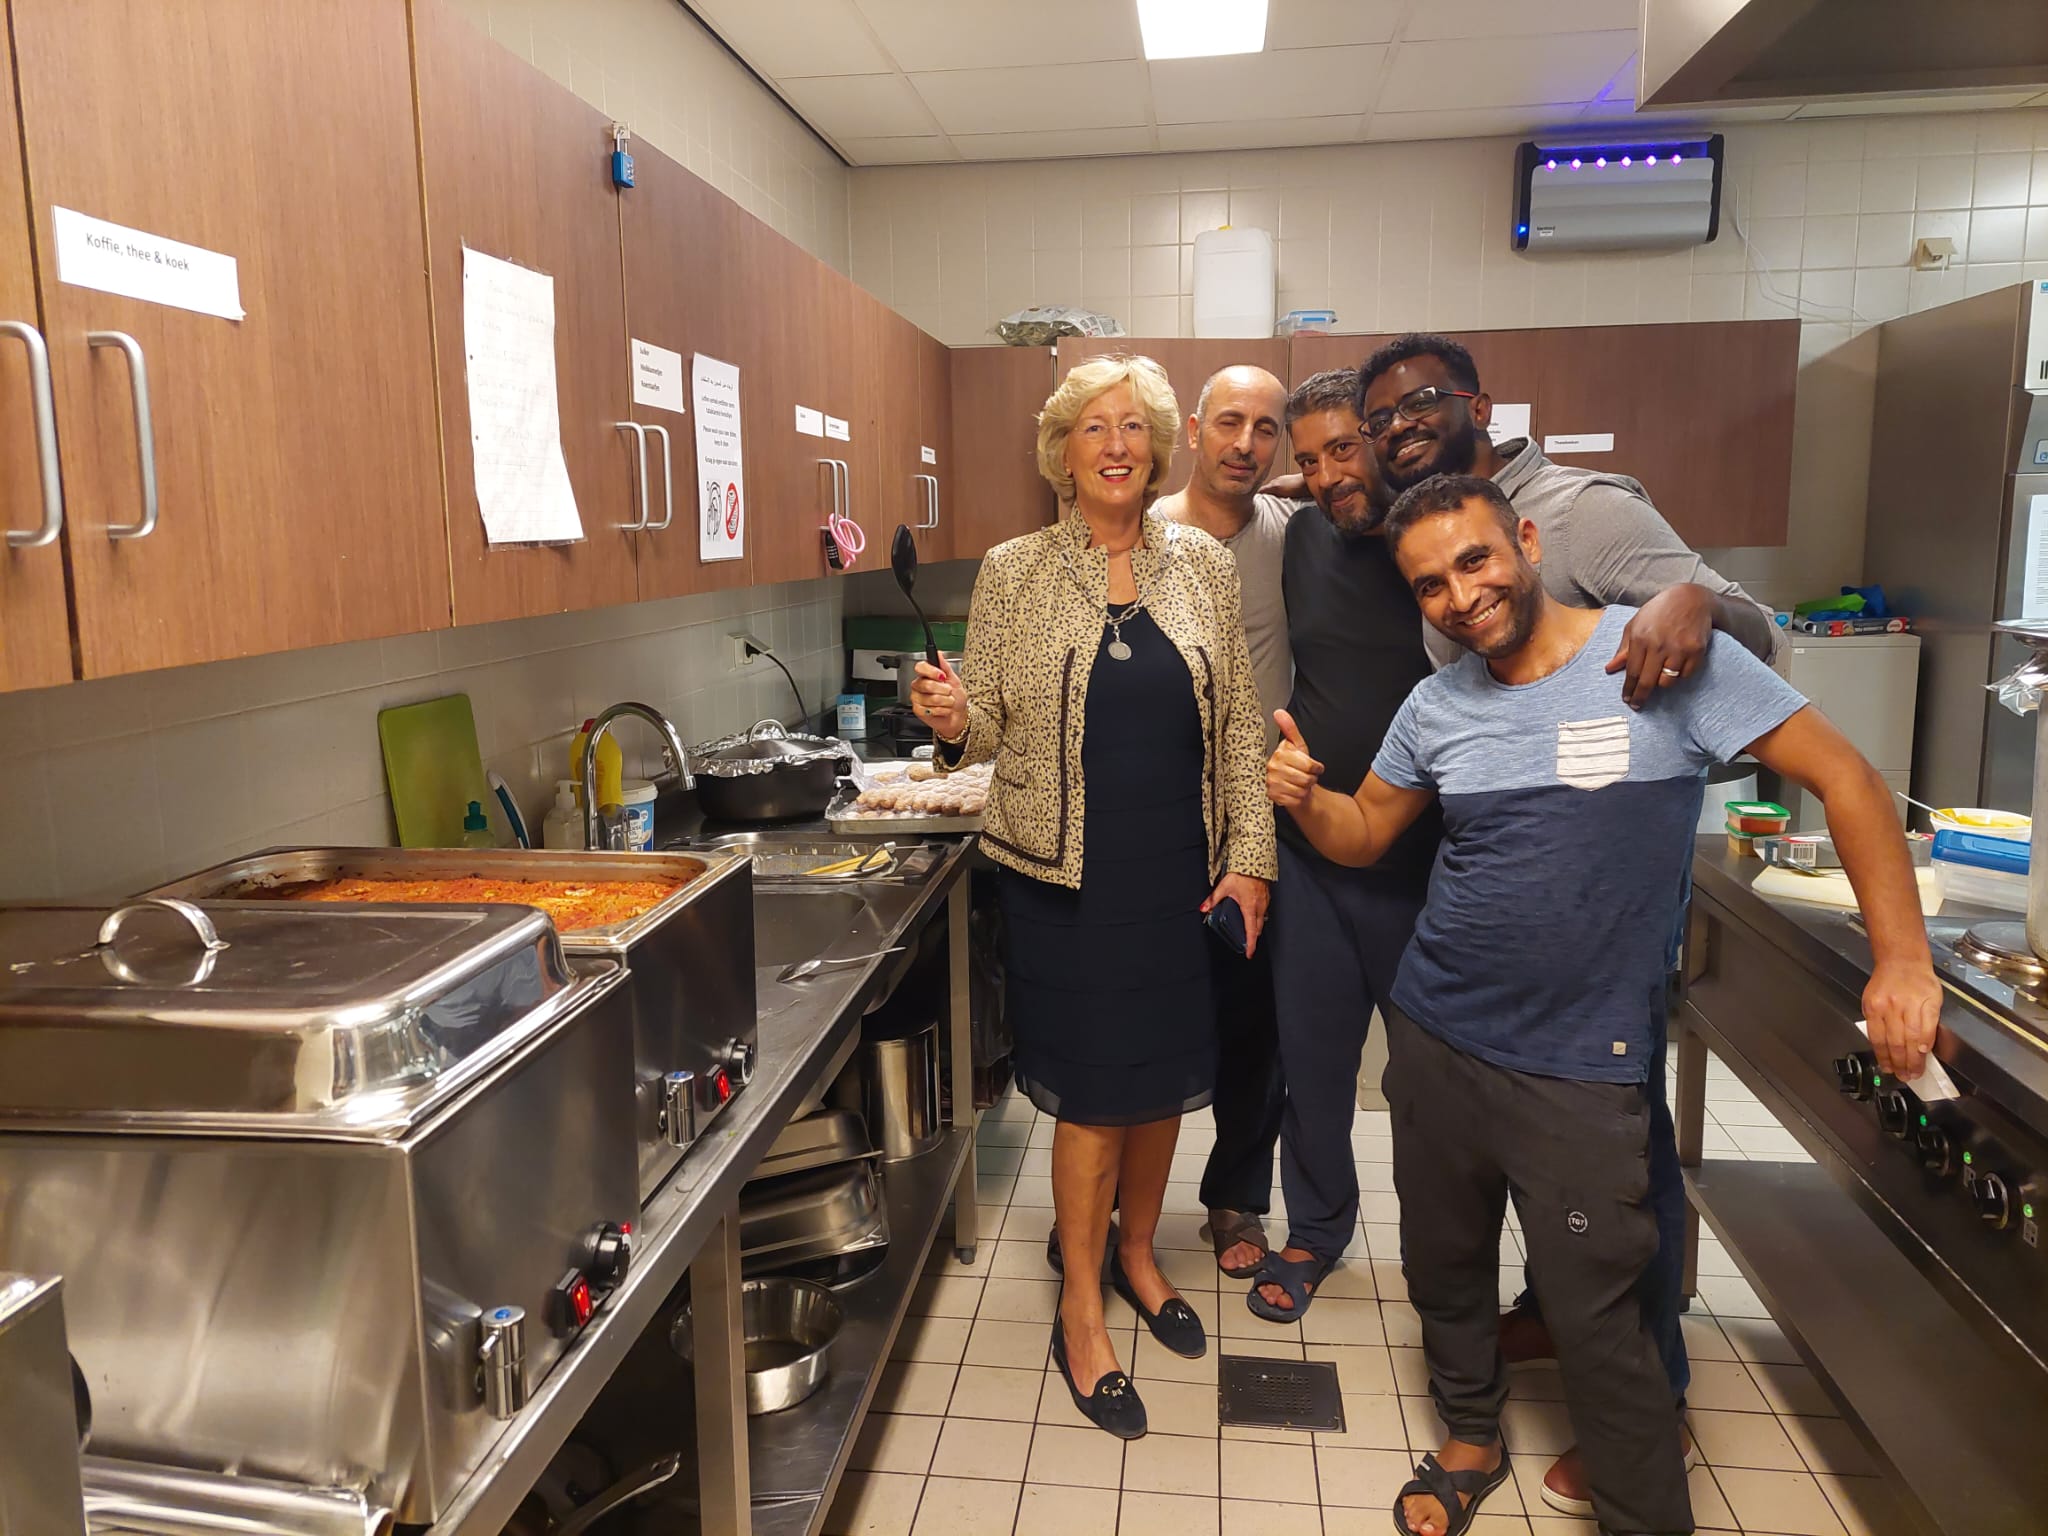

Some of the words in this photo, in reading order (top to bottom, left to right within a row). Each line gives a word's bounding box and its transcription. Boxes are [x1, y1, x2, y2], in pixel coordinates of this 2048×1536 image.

[86, 232, 124, 257] Koffie,
[126, 243, 151, 261] thee
[154, 250, 162, 264] &
[165, 253, 190, 272] koek
